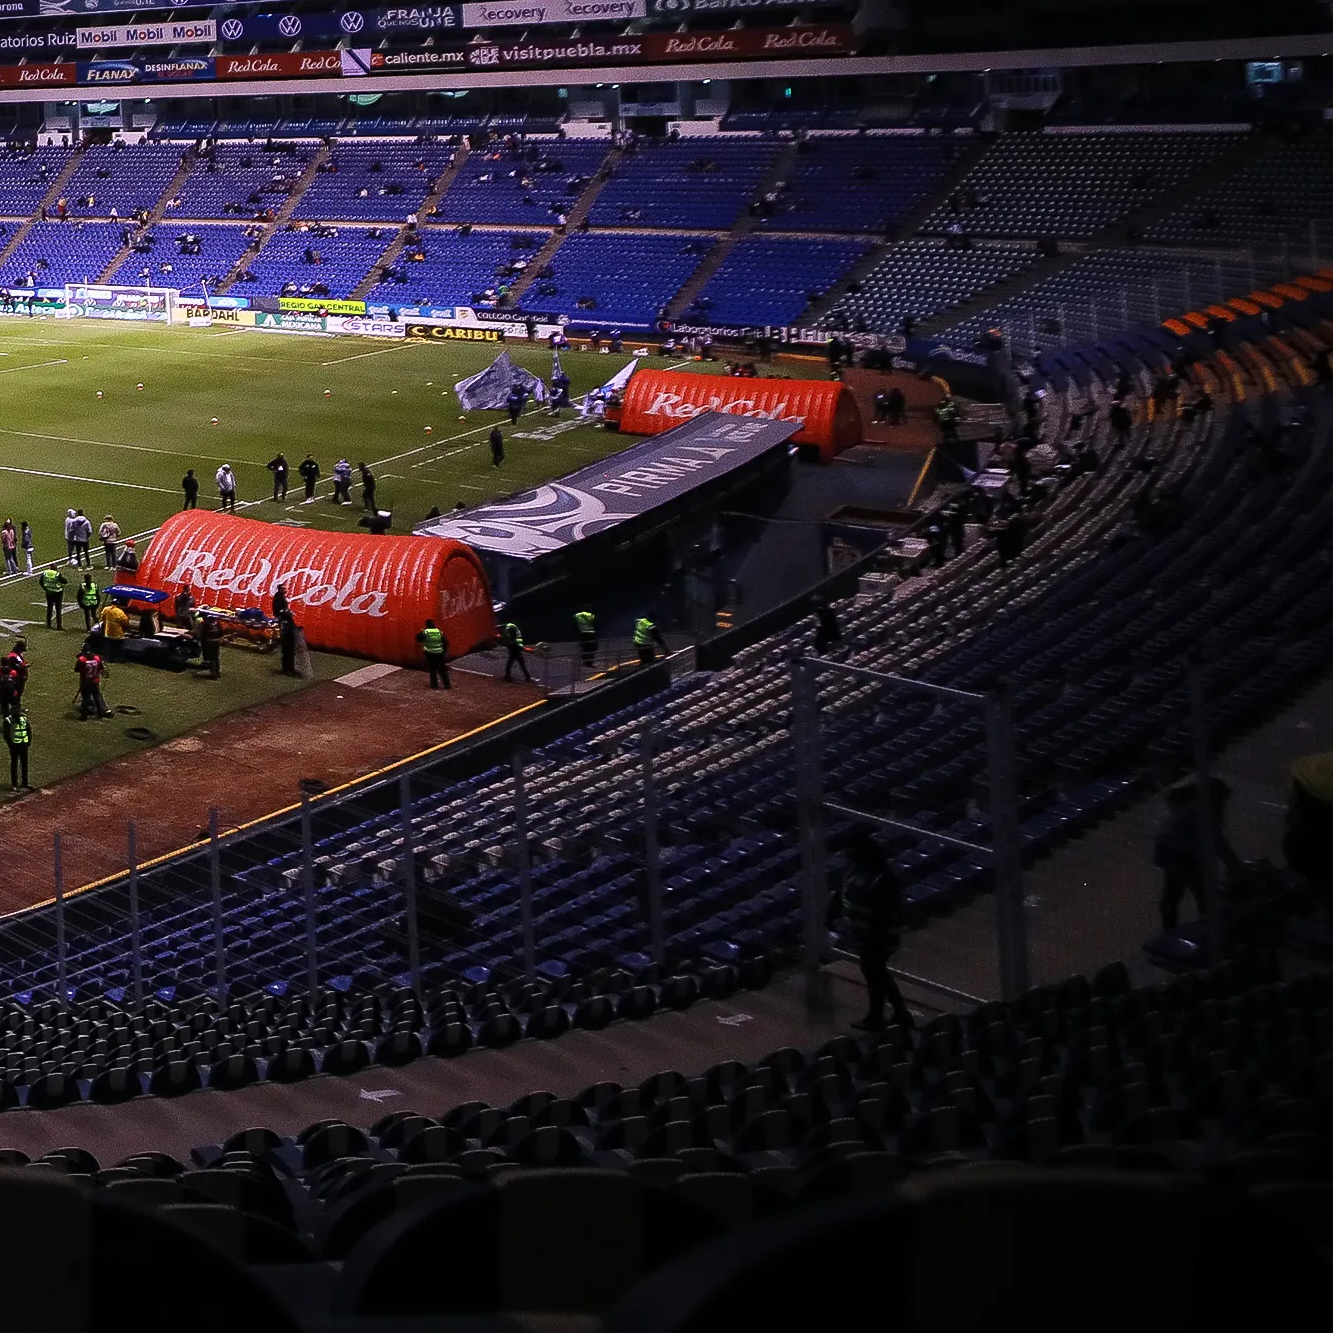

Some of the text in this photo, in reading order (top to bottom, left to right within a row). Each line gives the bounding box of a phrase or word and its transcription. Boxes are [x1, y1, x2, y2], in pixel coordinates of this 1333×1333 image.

[48, 33, 75, 46] Ruiz
[82, 24, 211, 44] Mobil Mobil Mobil
[386, 52, 464, 64] caliente.mx
[503, 43, 641, 61] visitpuebla.mx
[145, 62, 207, 72] DESINFLANAX
[87, 68, 135, 81] FLANAX
[325, 304, 365, 313] CENTRAL
[351, 322, 404, 333] STARS
[432, 327, 498, 341] CARIBU
[591, 457, 714, 497] PIRMA
